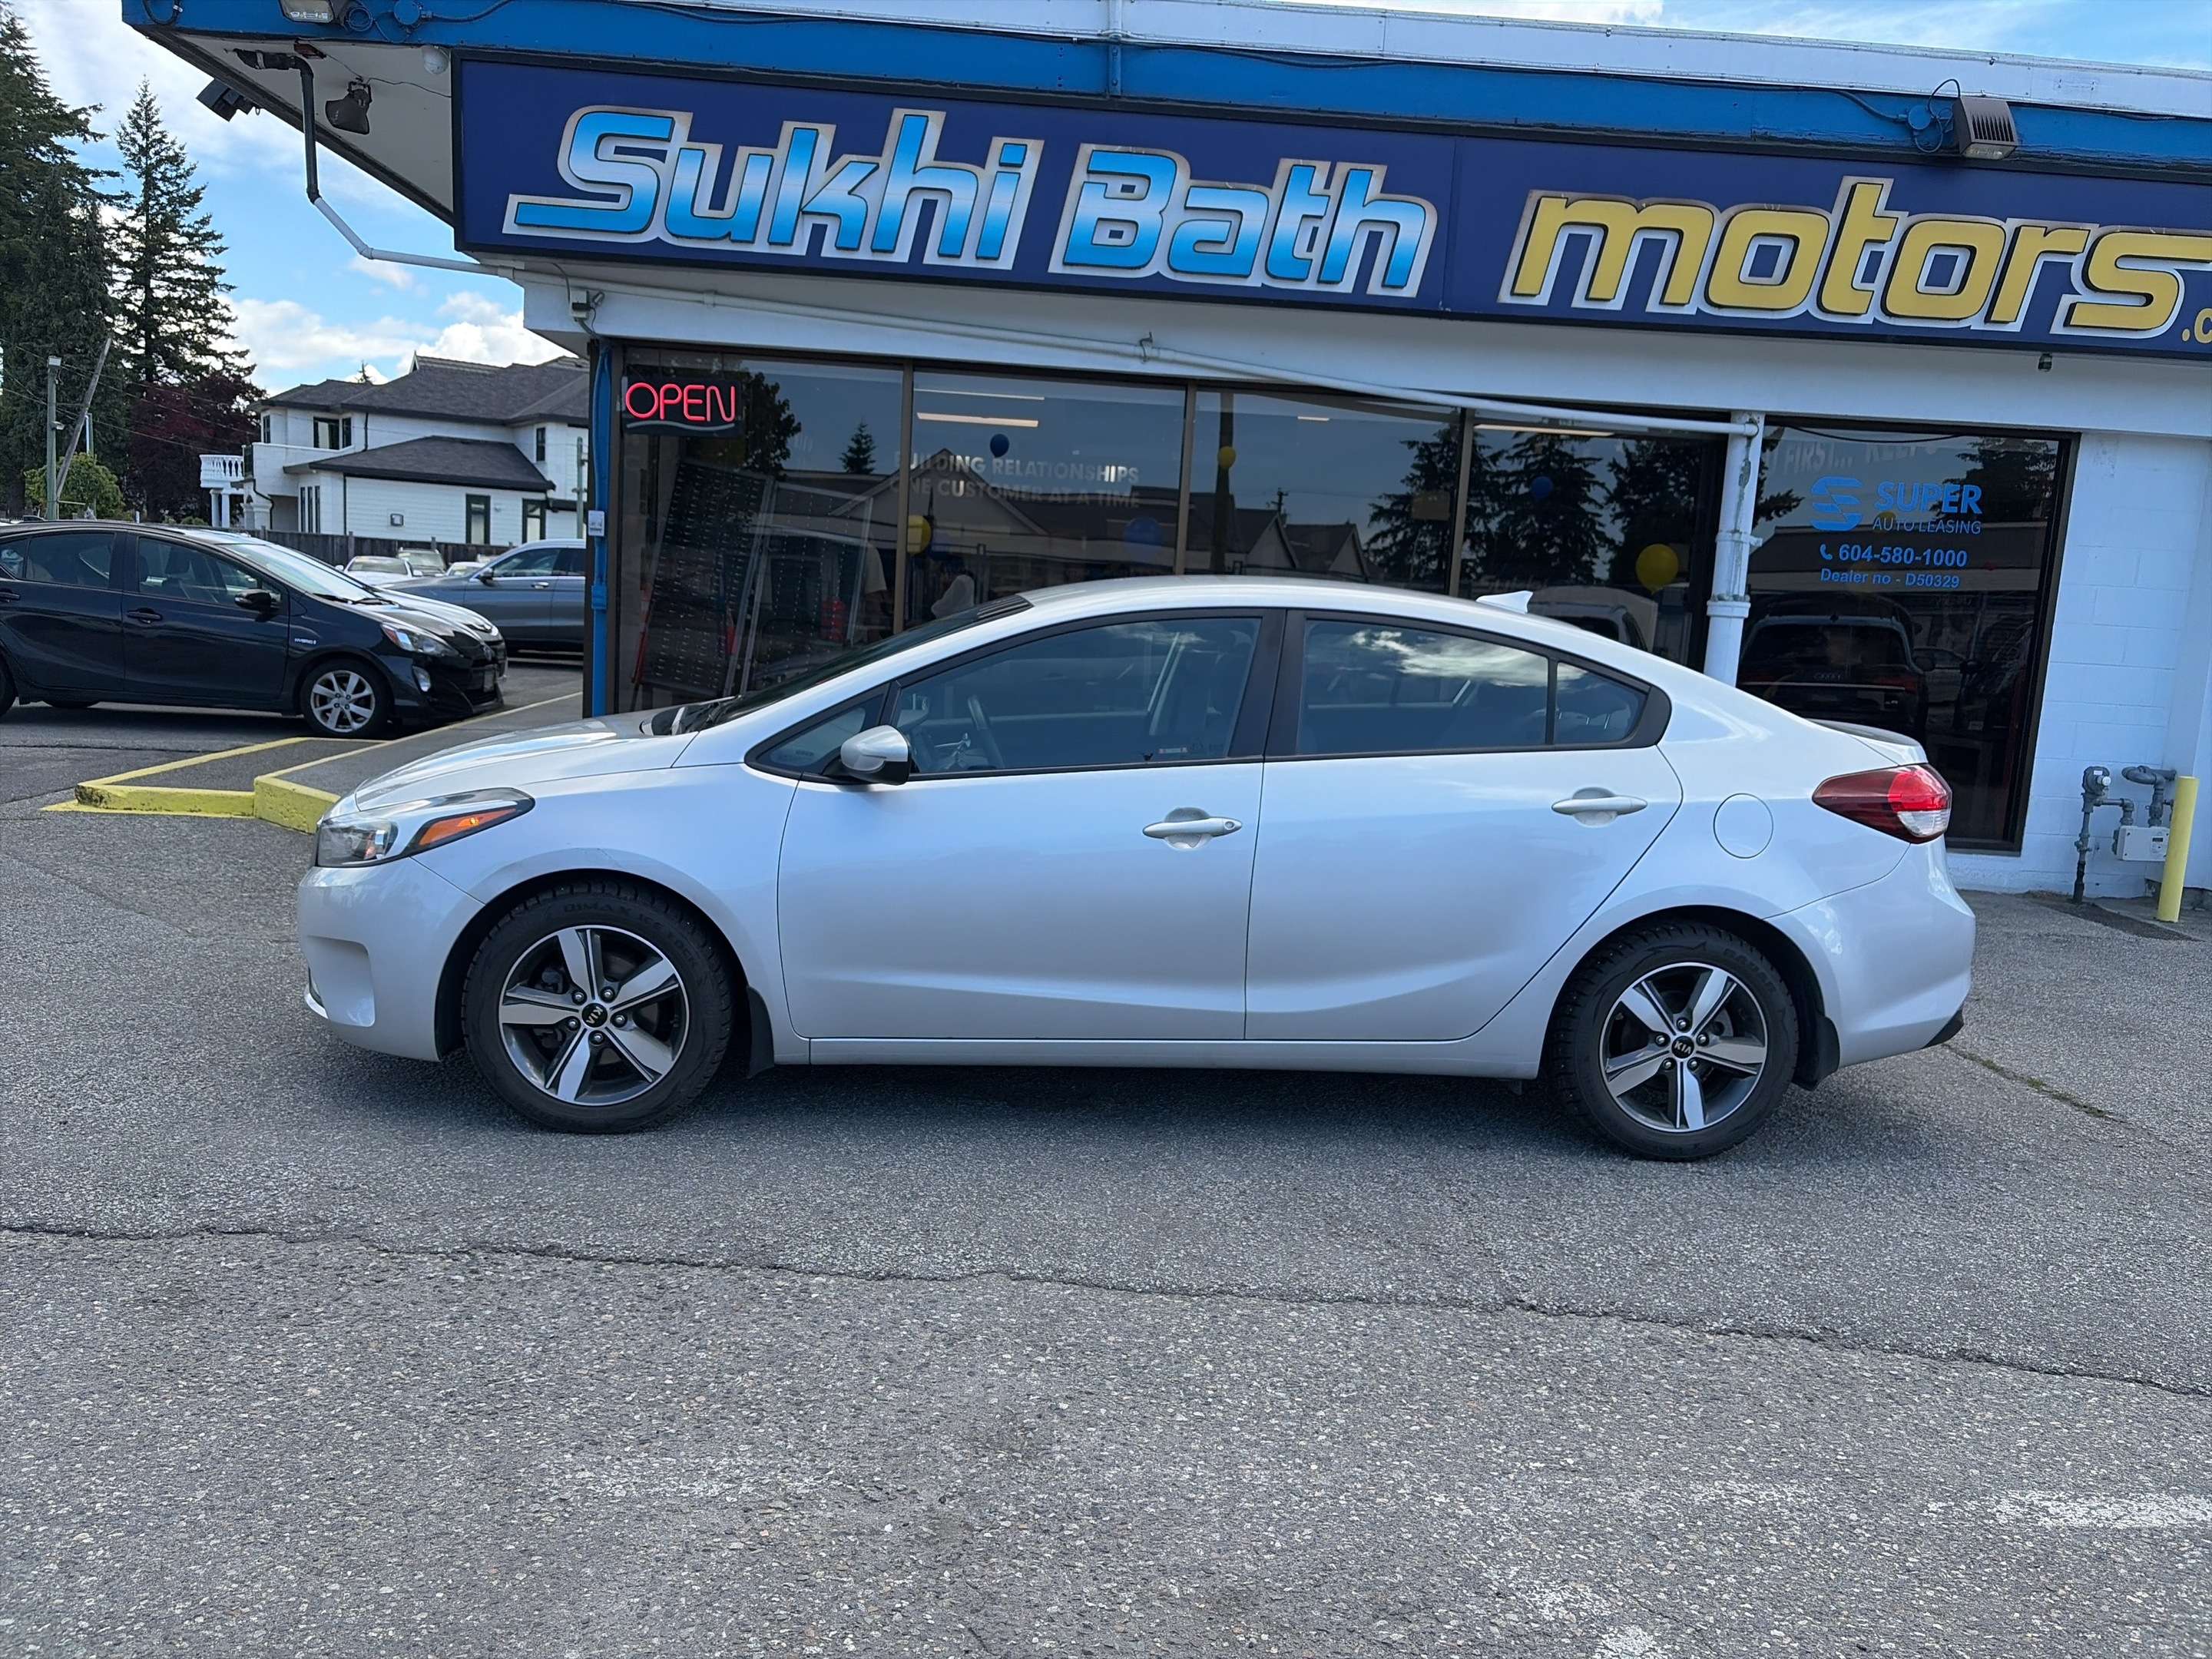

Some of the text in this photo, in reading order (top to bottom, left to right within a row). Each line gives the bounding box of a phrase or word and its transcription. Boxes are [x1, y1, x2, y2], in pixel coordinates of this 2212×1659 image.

[503, 105, 1043, 270] Sukhi
[1049, 144, 1436, 298] Bath
[1496, 176, 2212, 339] motors
[624, 382, 736, 422] OPEN
[992, 459, 1139, 484] RELATIONSHIPS
[1874, 481, 1983, 515] SUPER
[1873, 516, 1982, 535] AUTO LEASING
[1838, 544, 1968, 568] 604-580-1000
[1820, 568, 1868, 584] Dealer
[1873, 571, 1892, 585] no
[1905, 572, 1960, 589] D50329
[1674, 1040, 1692, 1055] KIA
